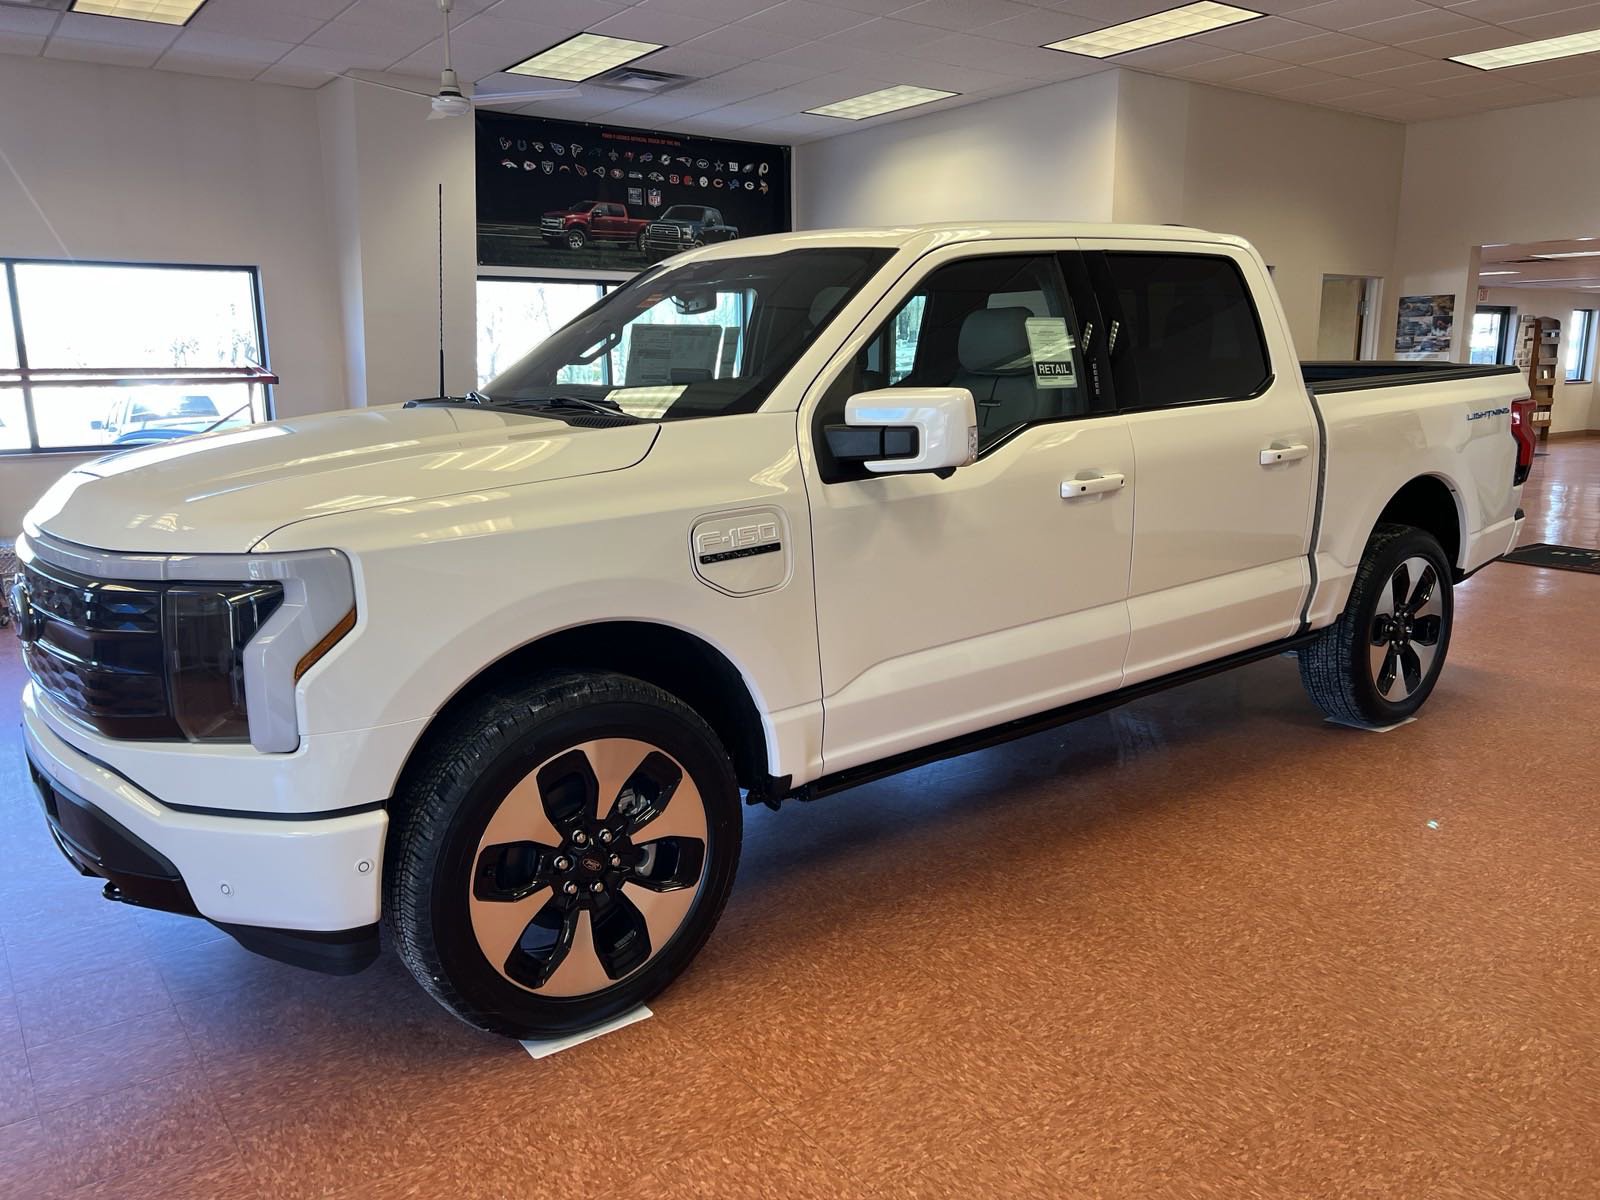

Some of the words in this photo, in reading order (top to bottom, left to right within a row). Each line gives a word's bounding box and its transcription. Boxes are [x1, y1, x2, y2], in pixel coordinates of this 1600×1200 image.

[1038, 363, 1070, 375] RETAIL
[1467, 407, 1510, 421] LIGHTNING
[697, 523, 777, 553] F-150
